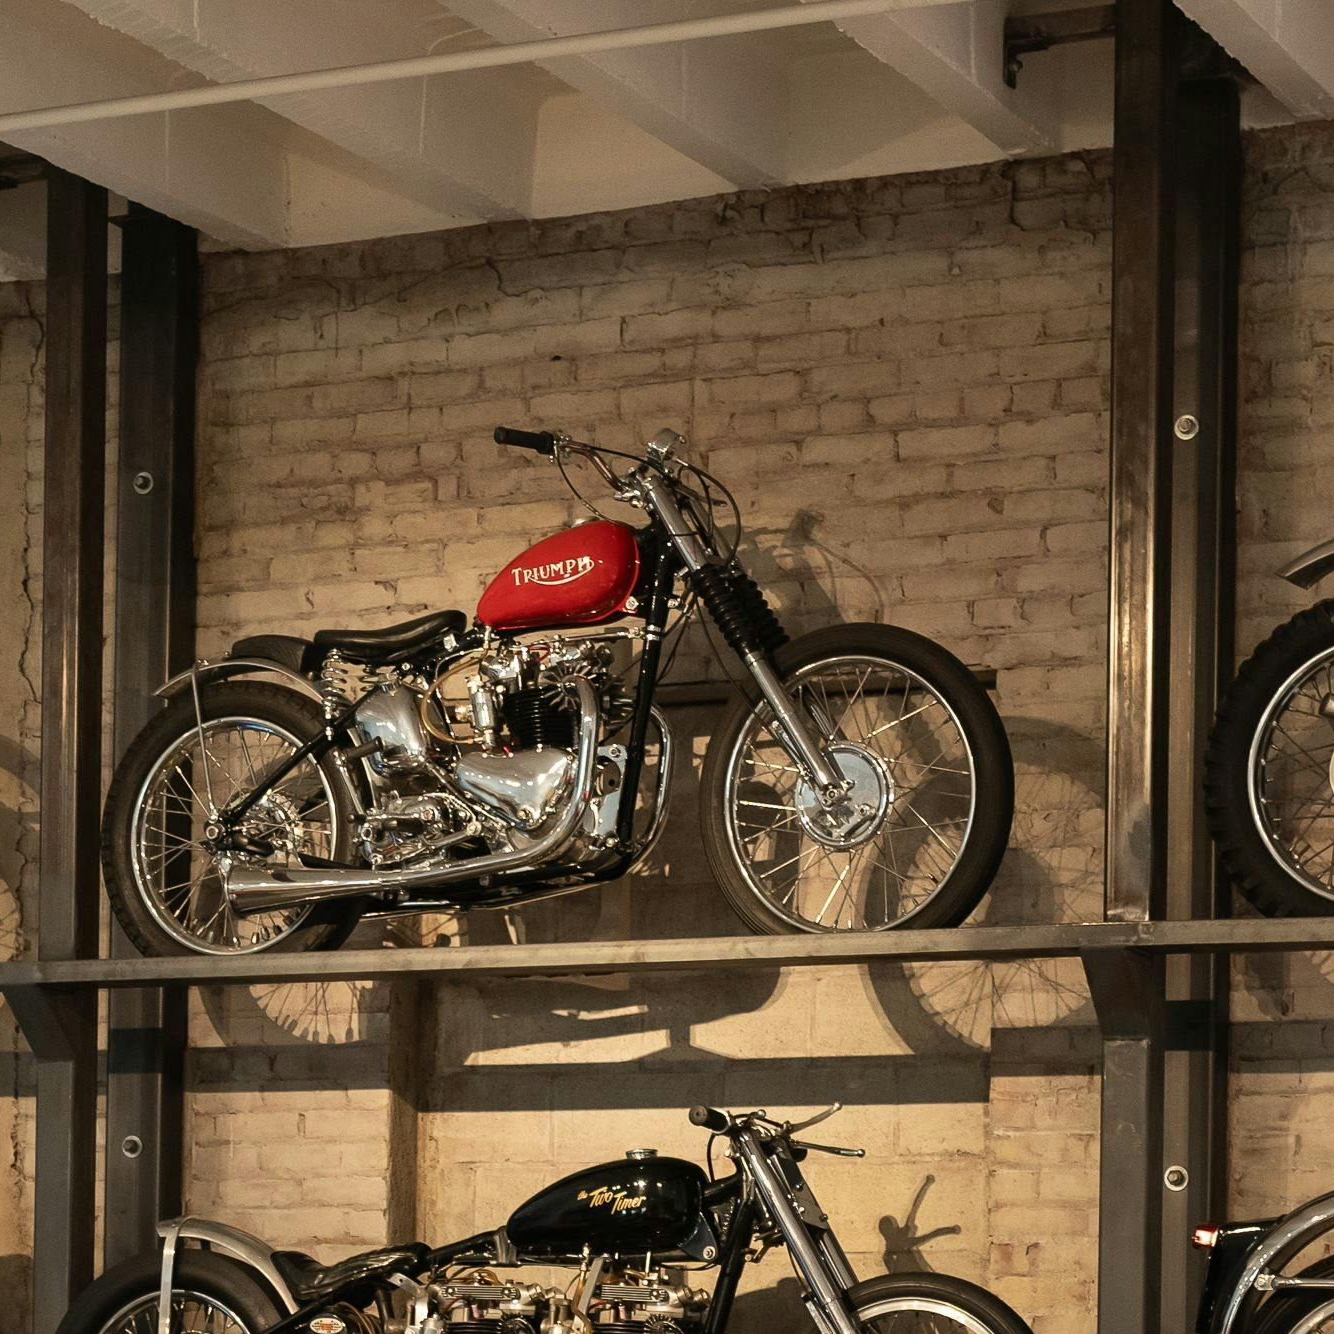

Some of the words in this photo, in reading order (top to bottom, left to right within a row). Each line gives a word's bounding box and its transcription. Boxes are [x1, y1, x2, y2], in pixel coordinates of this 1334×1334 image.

[511, 555, 596, 587] TRIUMPH
[589, 1186, 614, 1208] Two
[610, 1190, 648, 1216] Timer
